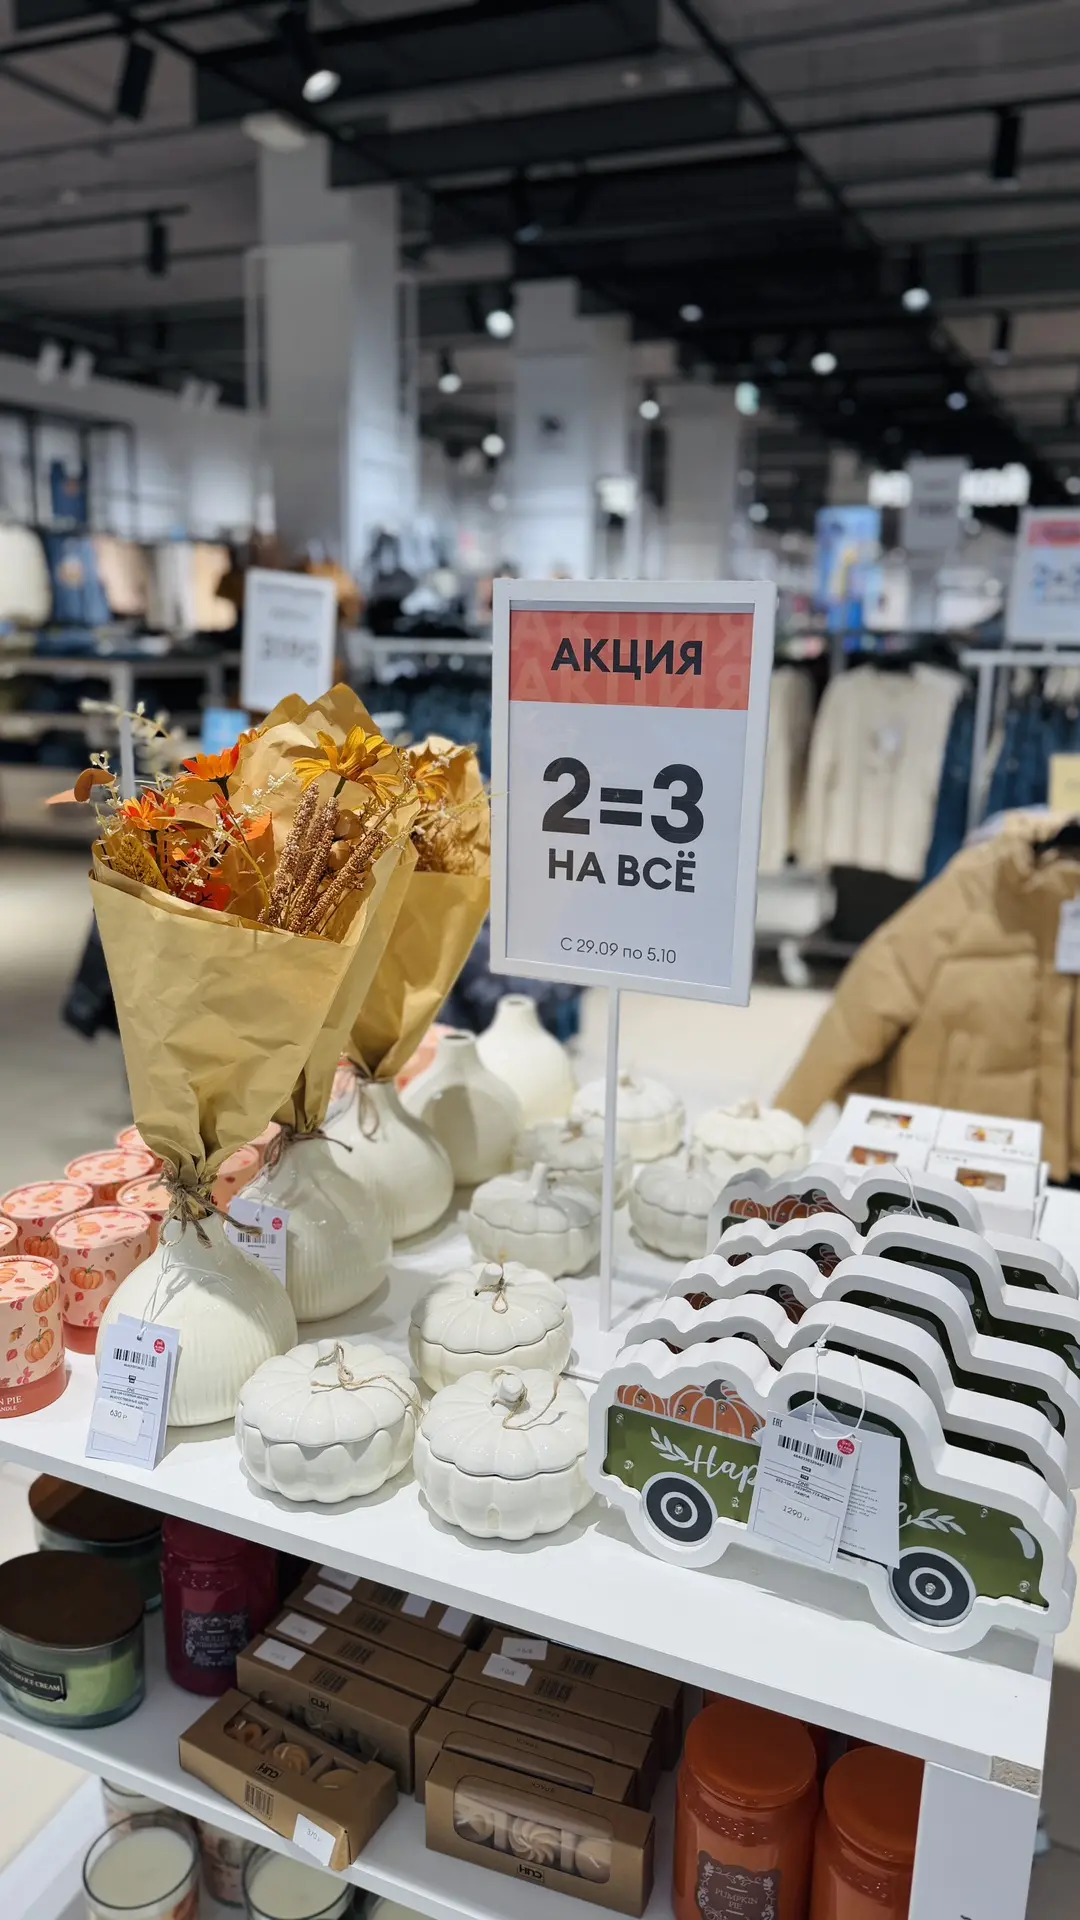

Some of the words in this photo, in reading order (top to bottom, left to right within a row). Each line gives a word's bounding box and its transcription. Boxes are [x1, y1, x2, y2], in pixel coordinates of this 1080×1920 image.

[551, 638, 703, 680] АКЦИЯ
[542, 757, 704, 844] 2=3
[548, 848, 606, 884] НА
[617, 850, 696, 893] ВСЁ
[560, 937, 573, 951] С
[576, 939, 619, 956] 29.09
[622, 947, 643, 960] по
[647, 947, 677, 964] 5.10
[7, 1395, 22, 1405] PIE
[109, 1409, 122, 1418] 630
[782, 1505, 803, 1519] 1290
[35, 1681, 61, 1691] CREAM
[715, 1887, 759, 1904] PUMPKIN
[728, 1901, 743, 1910] PIE
